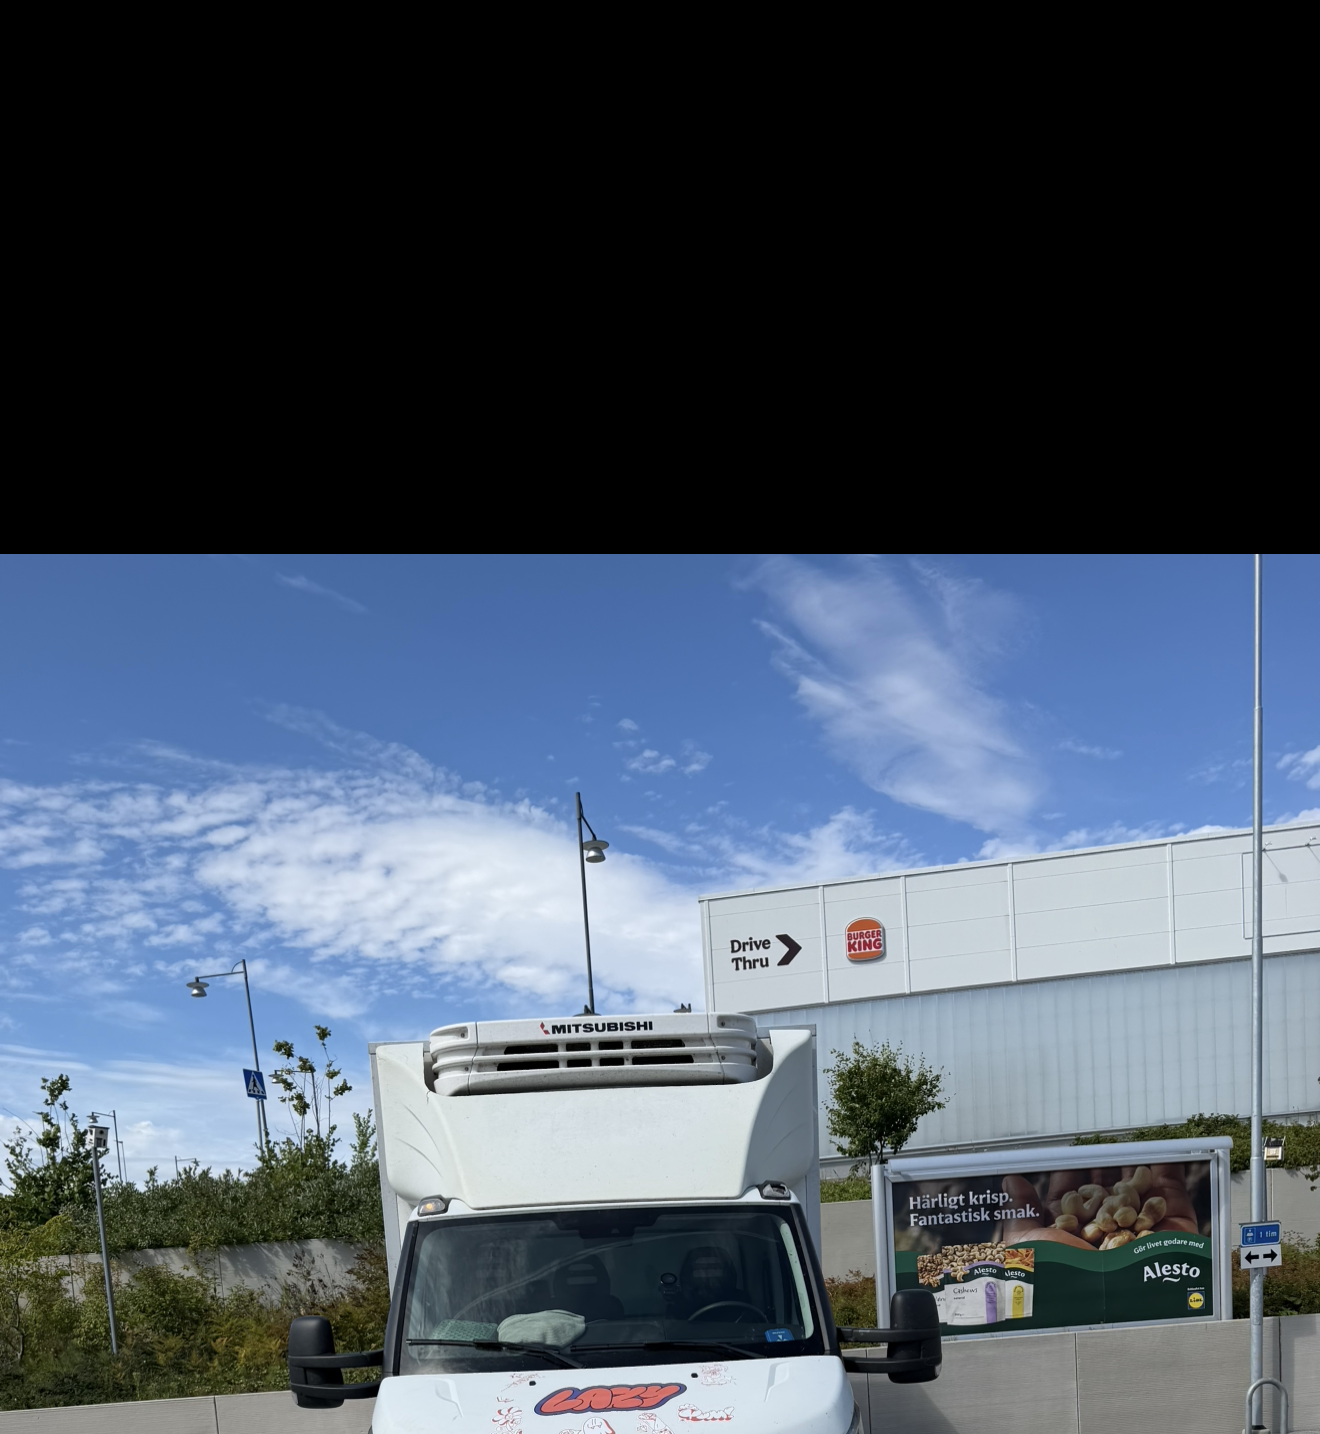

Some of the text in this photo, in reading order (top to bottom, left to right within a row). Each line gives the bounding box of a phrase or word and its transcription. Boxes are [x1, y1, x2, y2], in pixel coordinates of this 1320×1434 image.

[847, 929, 882, 941] BURGER
[730, 936, 771, 954] Drive
[847, 938, 883, 953] KING
[731, 956, 770, 972] Thru
[551, 1021, 653, 1035] MITSUBISHI
[909, 1188, 1013, 1211] Härligt krisp.
[909, 1204, 1040, 1227] Fantastisk smak.
[1265, 1230, 1277, 1238] tim
[1133, 1238, 1205, 1254] Gör livet godare med
[973, 1266, 997, 1275] Alesto
[1143, 1262, 1201, 1283] Alesto
[536, 1383, 686, 1415] LAZY
